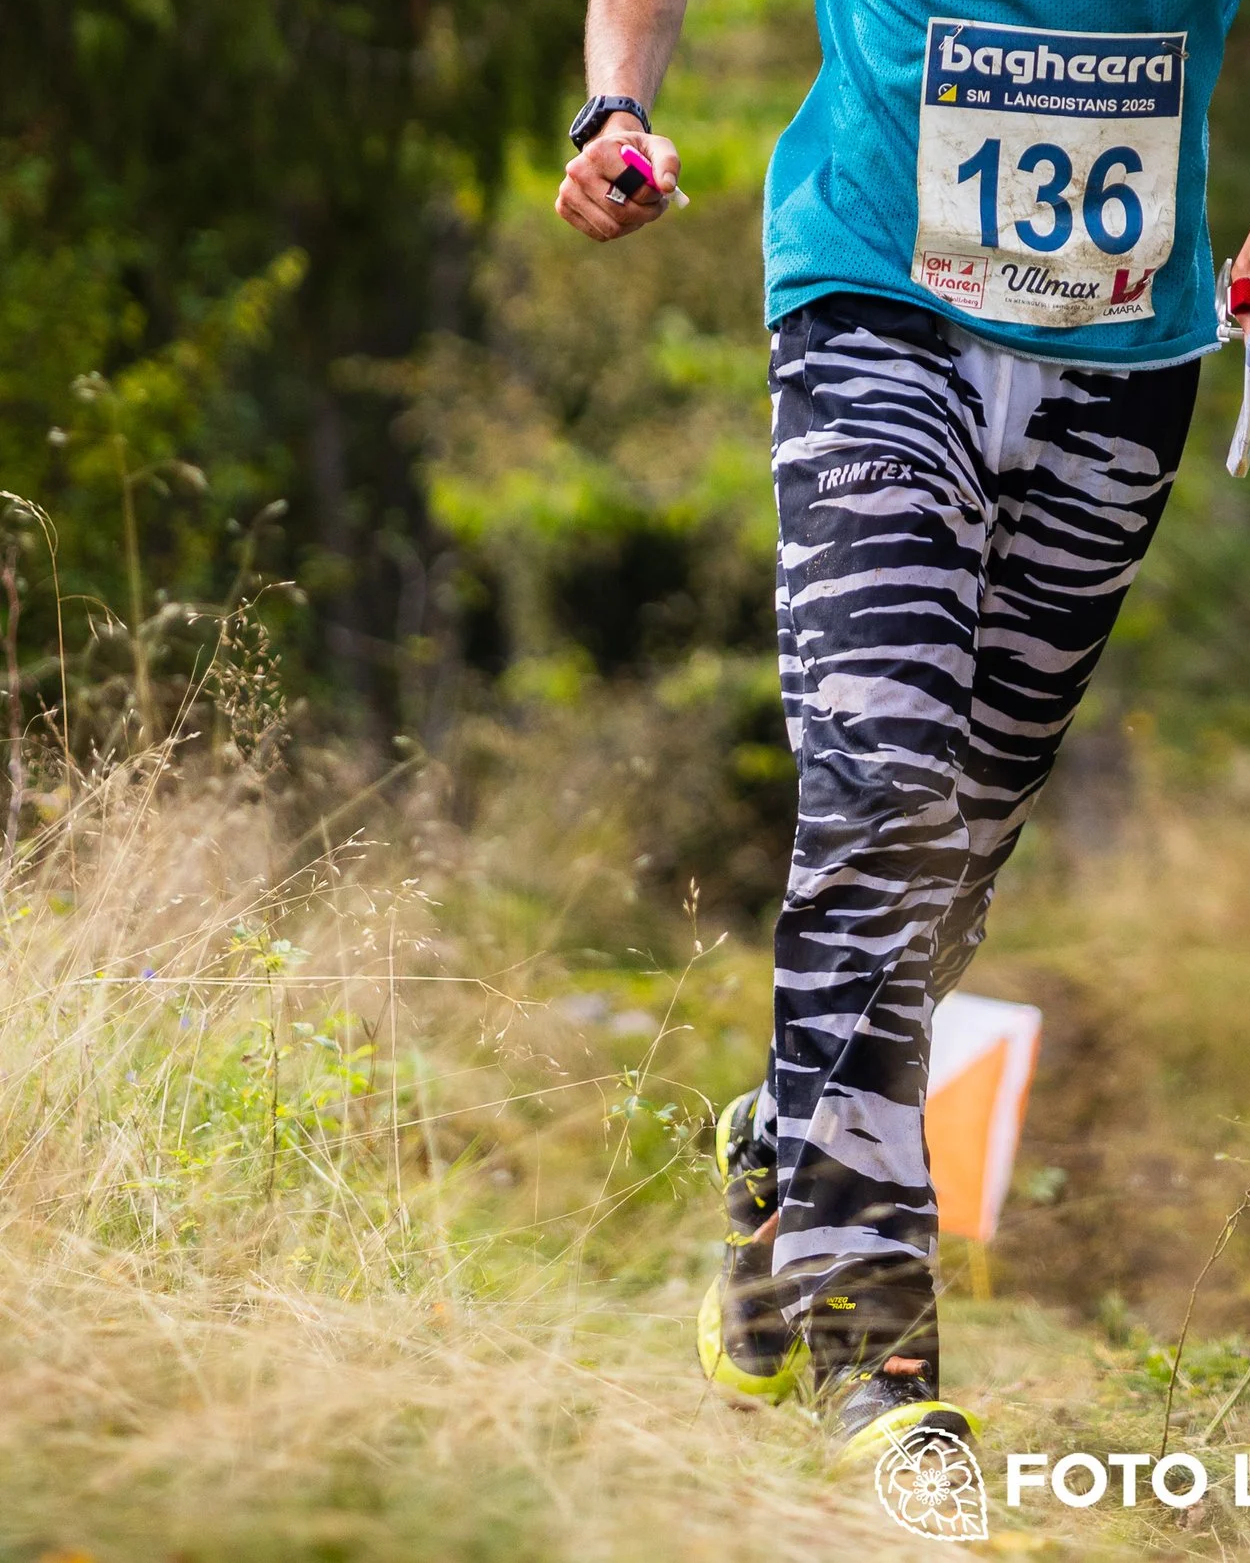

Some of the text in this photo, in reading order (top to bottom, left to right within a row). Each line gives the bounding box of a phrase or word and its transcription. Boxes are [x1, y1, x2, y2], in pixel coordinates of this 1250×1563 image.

[941, 35, 1173, 85] bagheera
[966, 89, 1156, 112] SM LÅNGDISTANS 2025
[957, 138, 1144, 256] 136
[926, 272, 980, 292] Tisaren
[1001, 263, 1100, 299] Ullmax
[1103, 304, 1143, 317] UMARA
[817, 460, 913, 494] TRIMTEX
